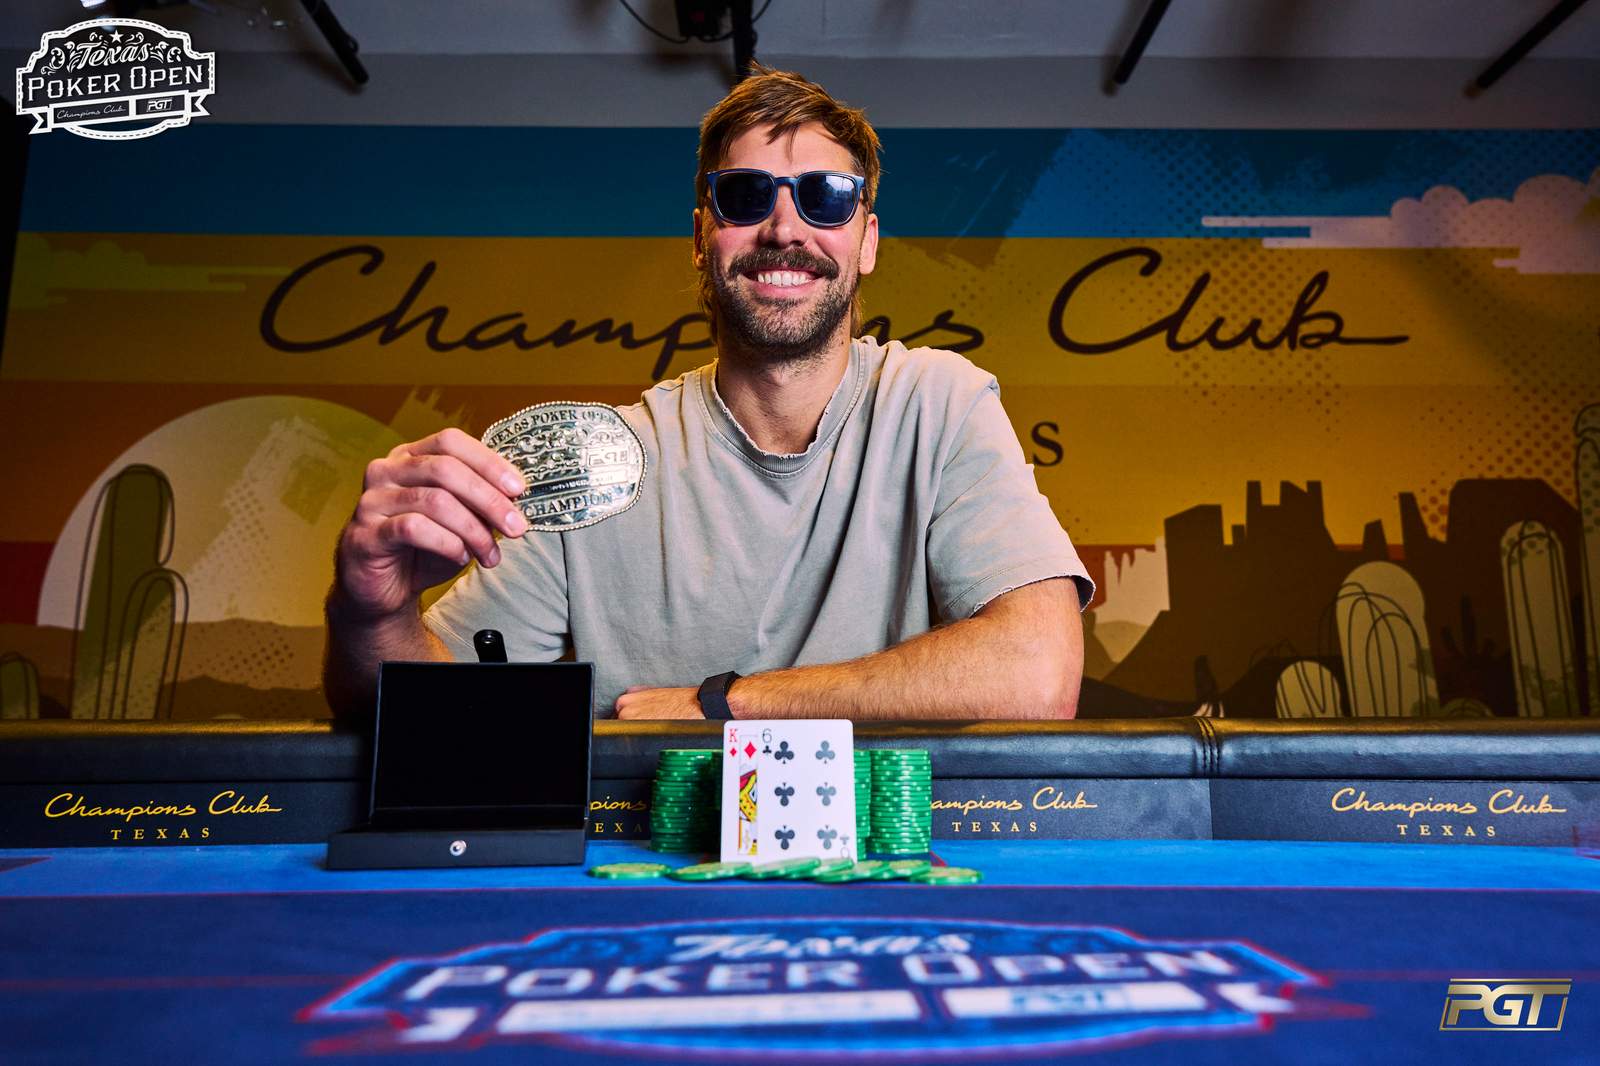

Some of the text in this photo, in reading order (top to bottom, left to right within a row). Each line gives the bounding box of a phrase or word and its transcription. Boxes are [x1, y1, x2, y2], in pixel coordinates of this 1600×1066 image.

[1048, 246, 1410, 355] Club
[491, 418, 529, 445] TEXAS
[531, 410, 578, 426] POKER
[523, 494, 613, 518] CHAMPION
[728, 728, 738, 743] K
[762, 728, 772, 744] 6
[44, 790, 282, 822] Champions Club
[590, 796, 647, 811] pions
[931, 787, 1098, 815] ampions Club
[1331, 788, 1567, 817] Champions Club
[110, 827, 210, 840] TEXAS
[951, 821, 1038, 832] TEXAS
[1397, 824, 1496, 837] TEXAS
[402, 950, 1236, 1000] POKER OPEN
